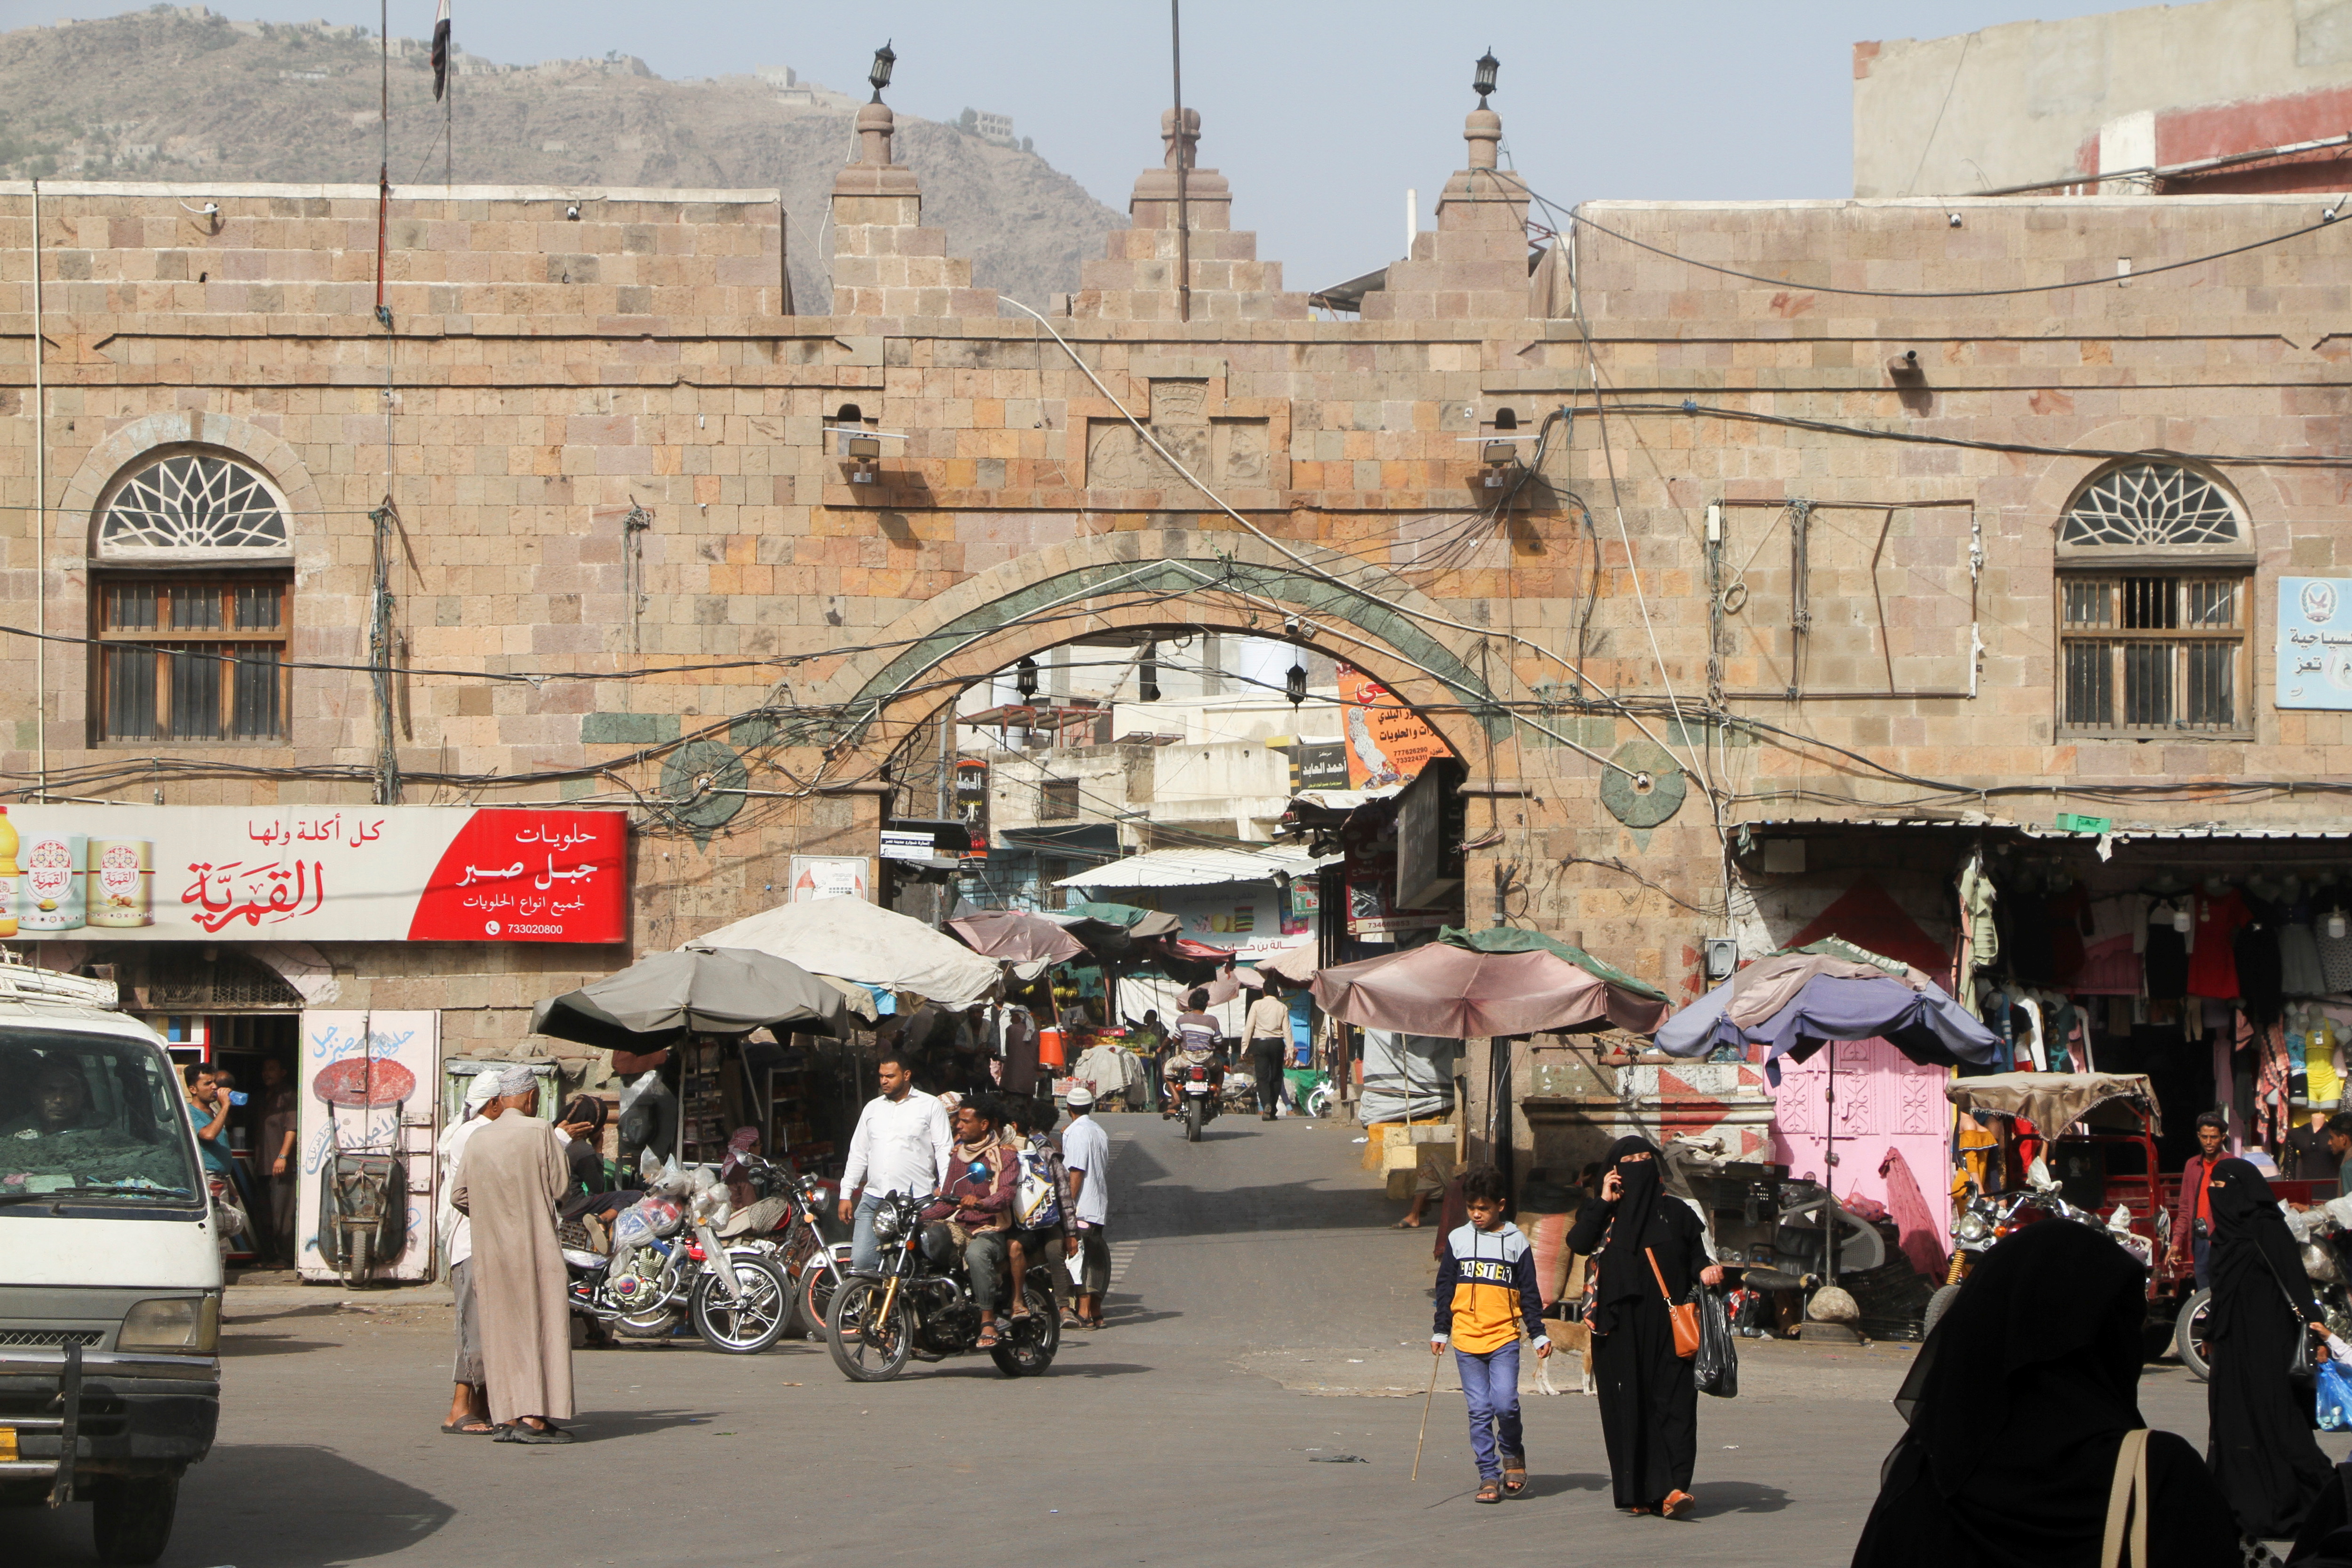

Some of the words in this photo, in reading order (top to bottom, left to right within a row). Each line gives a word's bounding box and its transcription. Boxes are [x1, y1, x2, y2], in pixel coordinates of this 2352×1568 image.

[2290, 629, 2352, 649] سياحية
[2295, 657, 2322, 674] تعز
[1378, 709, 1402, 724] البلدي
[1327, 756, 1347, 773] أحمد
[248, 819, 290, 846] ولها
[297, 812, 341, 840] أكلة
[350, 820, 384, 848] كل
[516, 823, 596, 851] حلويات
[455, 861, 524, 887] صبر
[534, 853, 597, 890] جبل
[463, 893, 514, 912] الحلويات
[519, 896, 546, 915] انواع
[550, 895, 585, 916] لجميع
[508, 924, 562, 934] 733020800
[1257, 942, 1268, 952] بن
[311, 1026, 338, 1058] جبل
[369, 1031, 414, 1063] حلويات
